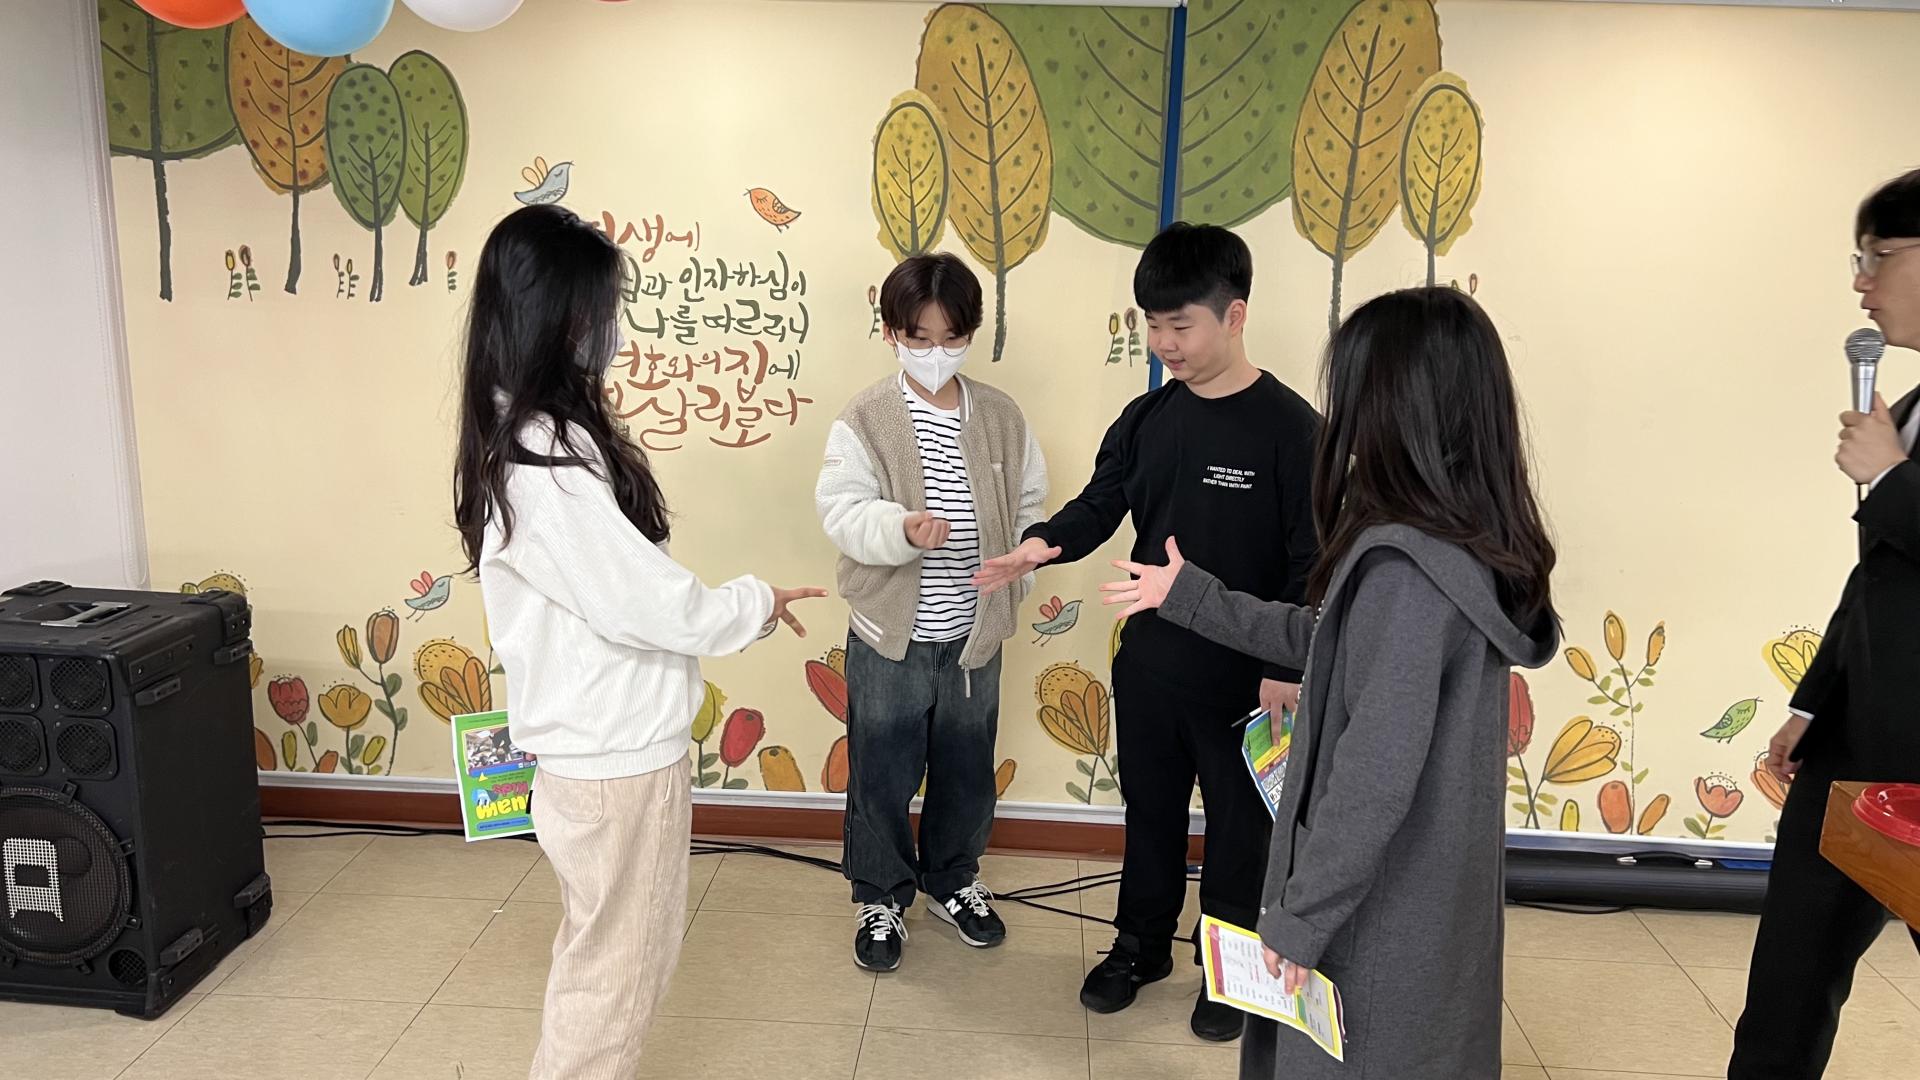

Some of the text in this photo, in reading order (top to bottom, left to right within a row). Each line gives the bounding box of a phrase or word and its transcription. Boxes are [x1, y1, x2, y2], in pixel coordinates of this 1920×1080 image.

[678, 251, 807, 302] 인자하심이
[625, 299, 810, 345] 나를 따르리니
[723, 340, 801, 404] 집에
[475, 794, 530, 820] men
[945, 898, 962, 915] N
